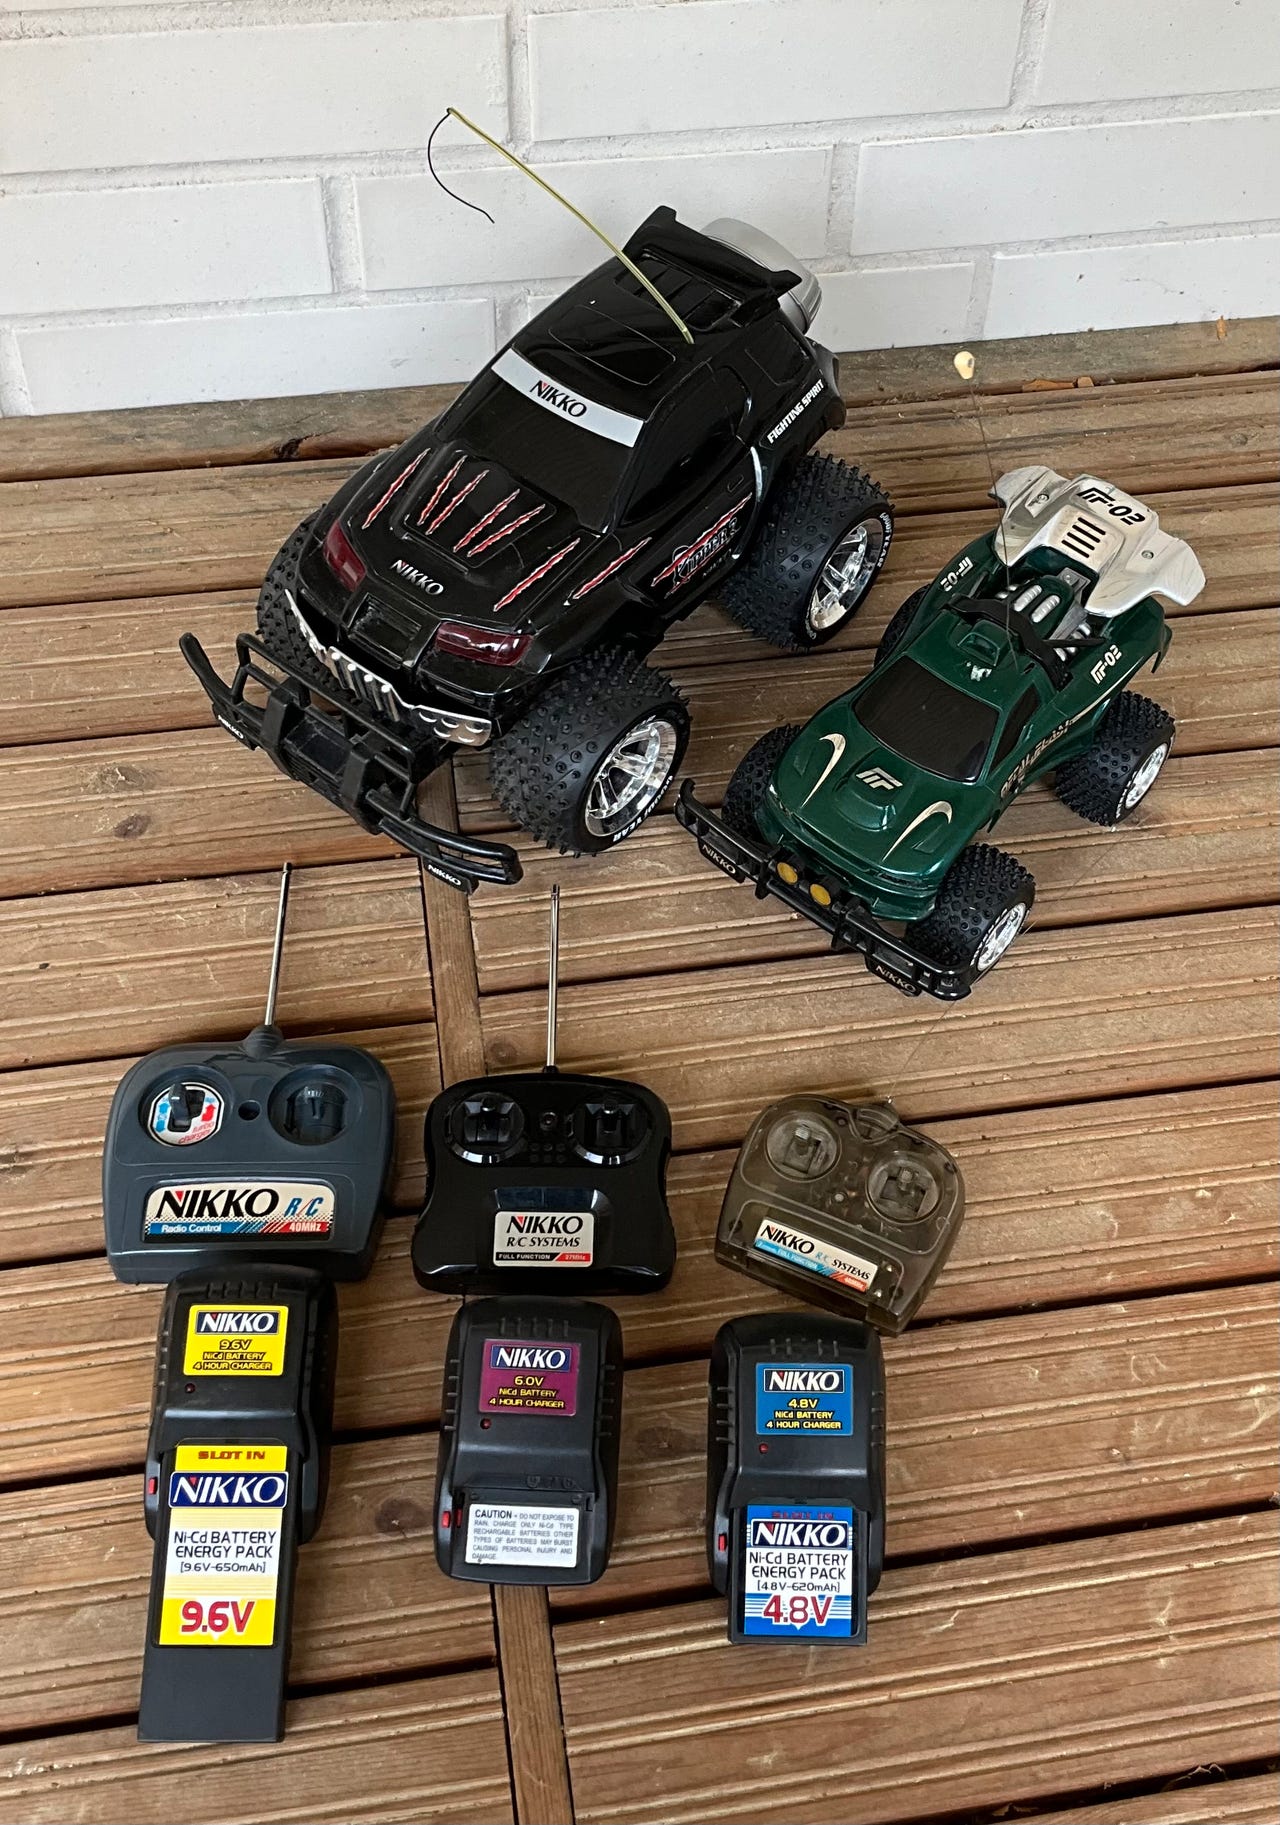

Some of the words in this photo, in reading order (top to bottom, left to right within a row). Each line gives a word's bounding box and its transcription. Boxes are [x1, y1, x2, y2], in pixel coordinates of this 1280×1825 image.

[530, 380, 587, 418] NIKKO
[767, 401, 805, 444] FIGHTING
[801, 379, 824, 408] SPIRIT
[390, 559, 444, 596] NIKKO
[217, 714, 244, 739] NIKKO
[702, 844, 736, 874] NIKKO
[428, 864, 462, 886] NIKKO
[875, 965, 916, 993] NIKKO
[156, 1188, 280, 1219] NIKKO
[283, 1197, 324, 1217] R/C
[161, 1224, 188, 1233] Radio
[188, 1223, 222, 1233] Control
[289, 1222, 322, 1233] 40MHz
[506, 1216, 584, 1235] NIKKO
[506, 1236, 528, 1248] R/C
[529, 1236, 581, 1248] SYSTEMS
[516, 1253, 551, 1261] FUNCTION
[760, 1224, 815, 1254] NIKKO
[831, 1259, 871, 1280] SYSTEMS
[200, 1313, 275, 1332] NIKKO
[219, 1339, 252, 1350] 9.6V
[203, 1352, 224, 1360] NiCd
[225, 1352, 266, 1360] BATTERY
[496, 1347, 566, 1369] NIKKO
[193, 1362, 202, 1370] 4
[203, 1362, 229, 1370] HOUR
[231, 1362, 273, 1370] CHARGER
[514, 1375, 545, 1386] 6.0V
[769, 1371, 840, 1391] NIKKO
[498, 1387, 518, 1396] NiCd
[520, 1388, 557, 1397] BATTERY
[489, 1397, 496, 1405] 4
[499, 1398, 523, 1406] HOUR
[525, 1399, 565, 1408] CHARGER
[788, 1398, 818, 1409] 4.8V
[775, 1410, 794, 1418] NiCd
[796, 1411, 833, 1419] BATTERY
[766, 1421, 773, 1429] 4
[776, 1421, 800, 1429] HOUR
[802, 1421, 841, 1429] CHARGER
[198, 1450, 242, 1460] SLOT
[246, 1451, 265, 1460] IN
[172, 1476, 285, 1504] NIKKO
[474, 1509, 513, 1519] CAUTION
[174, 1530, 208, 1544] Ni-Cd
[211, 1531, 277, 1544] BATTERY
[754, 1522, 846, 1547] NIKKO
[175, 1545, 231, 1558] ENERGY
[235, 1545, 273, 1558] PACK
[749, 1551, 782, 1564] Ni-Cd
[787, 1552, 849, 1566] BATTERY
[751, 1565, 806, 1579] ENERGY
[810, 1566, 846, 1580] PACK
[181, 1600, 255, 1632] 9.6V
[763, 1594, 833, 1624] 4.8V
